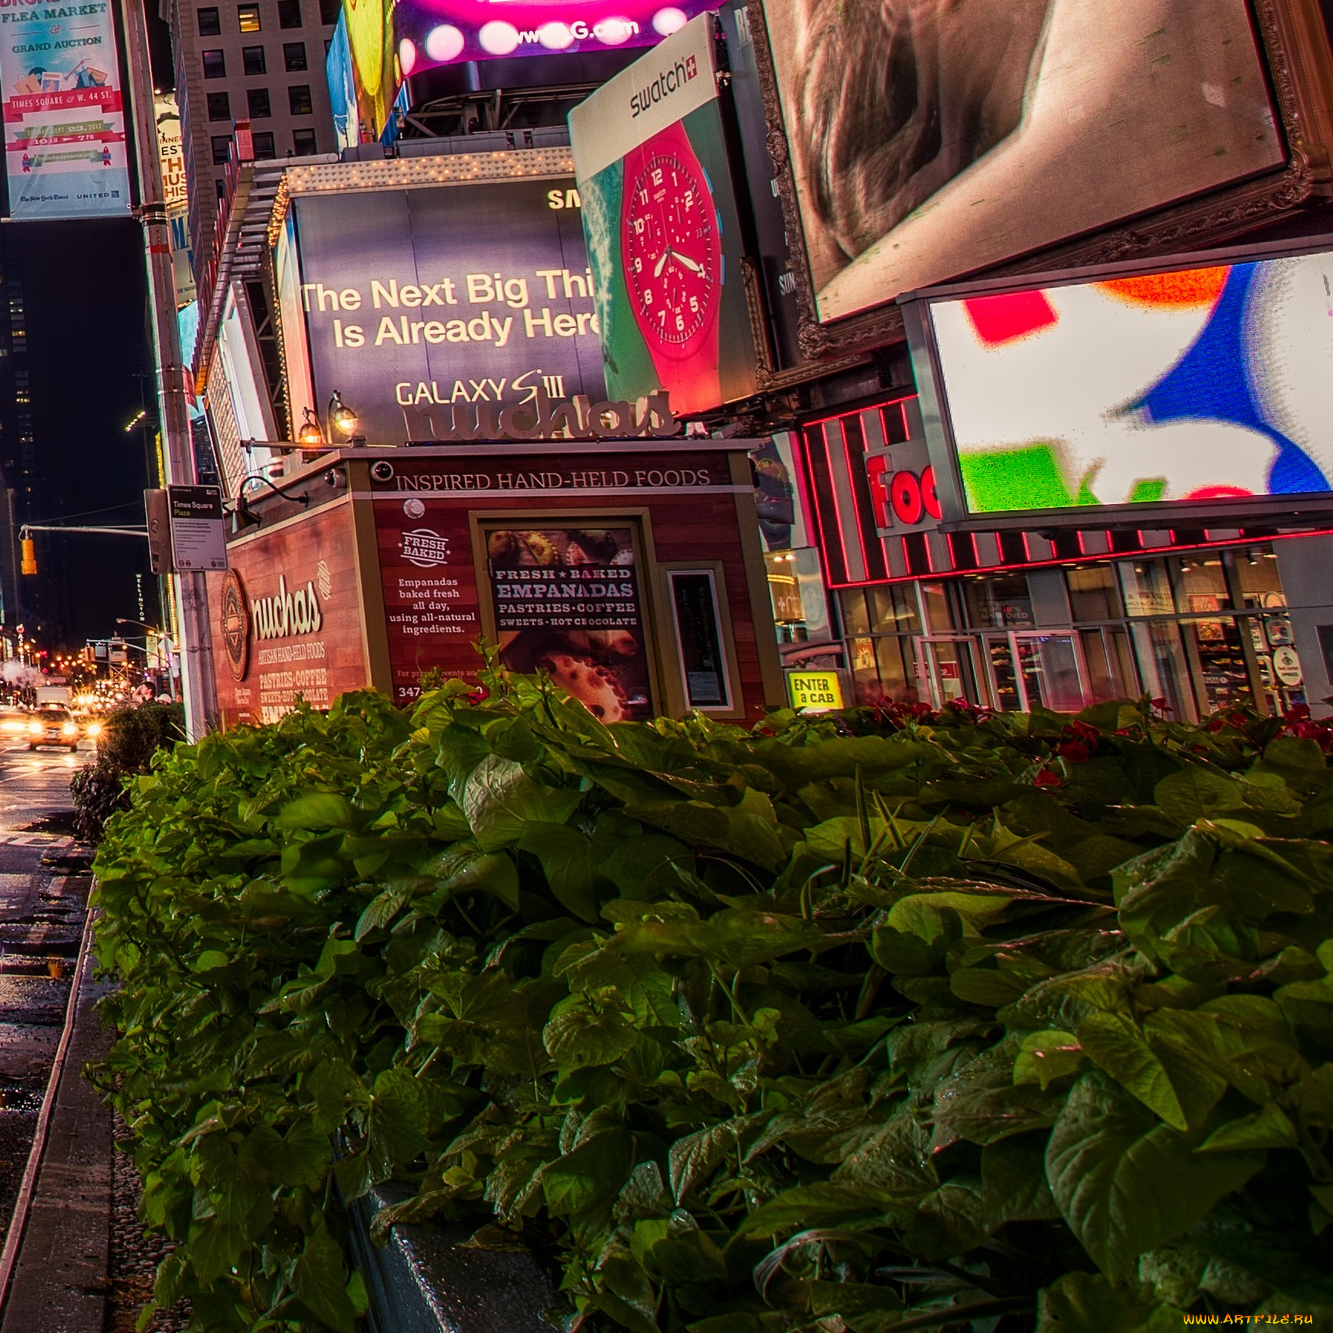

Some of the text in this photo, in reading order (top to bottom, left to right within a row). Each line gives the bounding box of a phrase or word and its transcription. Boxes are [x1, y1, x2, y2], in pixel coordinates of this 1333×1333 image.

[1, 3, 107, 23] FLEA MARKET
[12, 36, 102, 54] GRAND AUCTION
[629, 56, 687, 119] swatch
[12, 90, 112, 109] TIMES SQUARE W. 44 ST.
[77, 192, 110, 200] UNITED
[301, 268, 594, 312] The Next Big Thi
[333, 319, 365, 348] Is
[375, 310, 513, 348] Already
[395, 378, 506, 406] GALAXY
[401, 388, 682, 443] nuchas
[396, 469, 711, 491] INSPIRED HAND-HELD FOODS
[173, 500, 214, 510] Times Square
[404, 536, 446, 551] FRESH
[403, 546, 445, 561] BAKED
[495, 569, 631, 580] FRESH BAKED
[398, 578, 458, 589] Empanadas
[497, 583, 634, 598] EMPANADAS
[135, 573, 145, 621] WELLINGTON
[399, 588, 460, 599] baked fresh
[251, 574, 323, 640] nuchas
[413, 601, 450, 613] all day,
[389, 612, 476, 625] using all-natural
[499, 617, 637, 627] SWEETS HOT CHOCOLATE
[402, 624, 465, 636] ingredients.
[258, 641, 326, 665] ARTISAN HAND-HELD FOODS
[794, 677, 829, 692] ENTER
[260, 690, 282, 704] SWEETS
[810, 691, 835, 704] CAB
